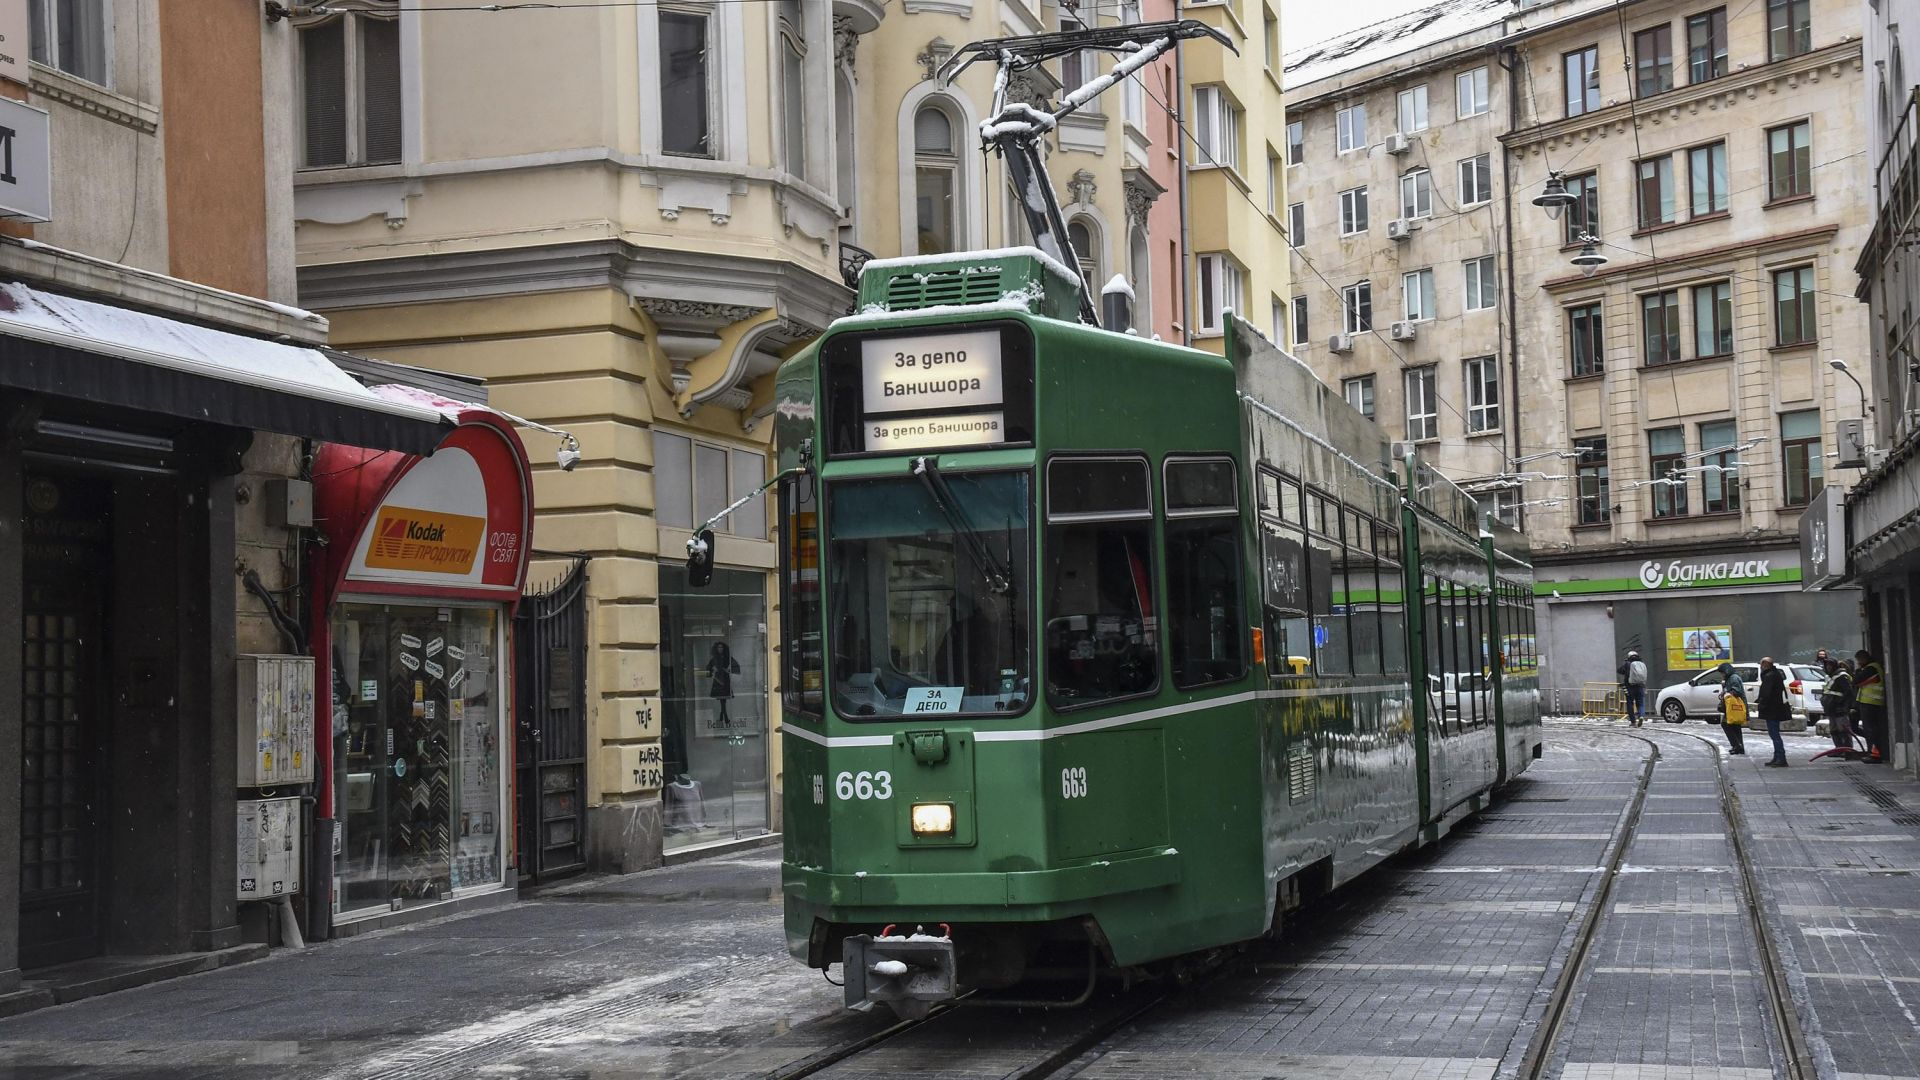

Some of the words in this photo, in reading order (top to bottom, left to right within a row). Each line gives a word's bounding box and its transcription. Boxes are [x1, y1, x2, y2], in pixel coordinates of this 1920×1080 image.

[895, 352, 916, 368] За
[922, 350, 967, 370] депо
[884, 377, 981, 397] Банишора
[873, 426, 888, 438] За
[893, 426, 925, 439] депо
[929, 420, 998, 434] Банишора
[406, 520, 445, 542] Kodak
[414, 544, 471, 564] ПРОДУКТИ
[492, 548, 518, 563] СВЯТ
[1667, 560, 1728, 581] банка
[1729, 560, 1770, 579] ДСК
[927, 690, 942, 699] ЗА
[915, 701, 948, 712] ДЕПО
[836, 770, 893, 801] 663
[1061, 766, 1087, 799] 663
